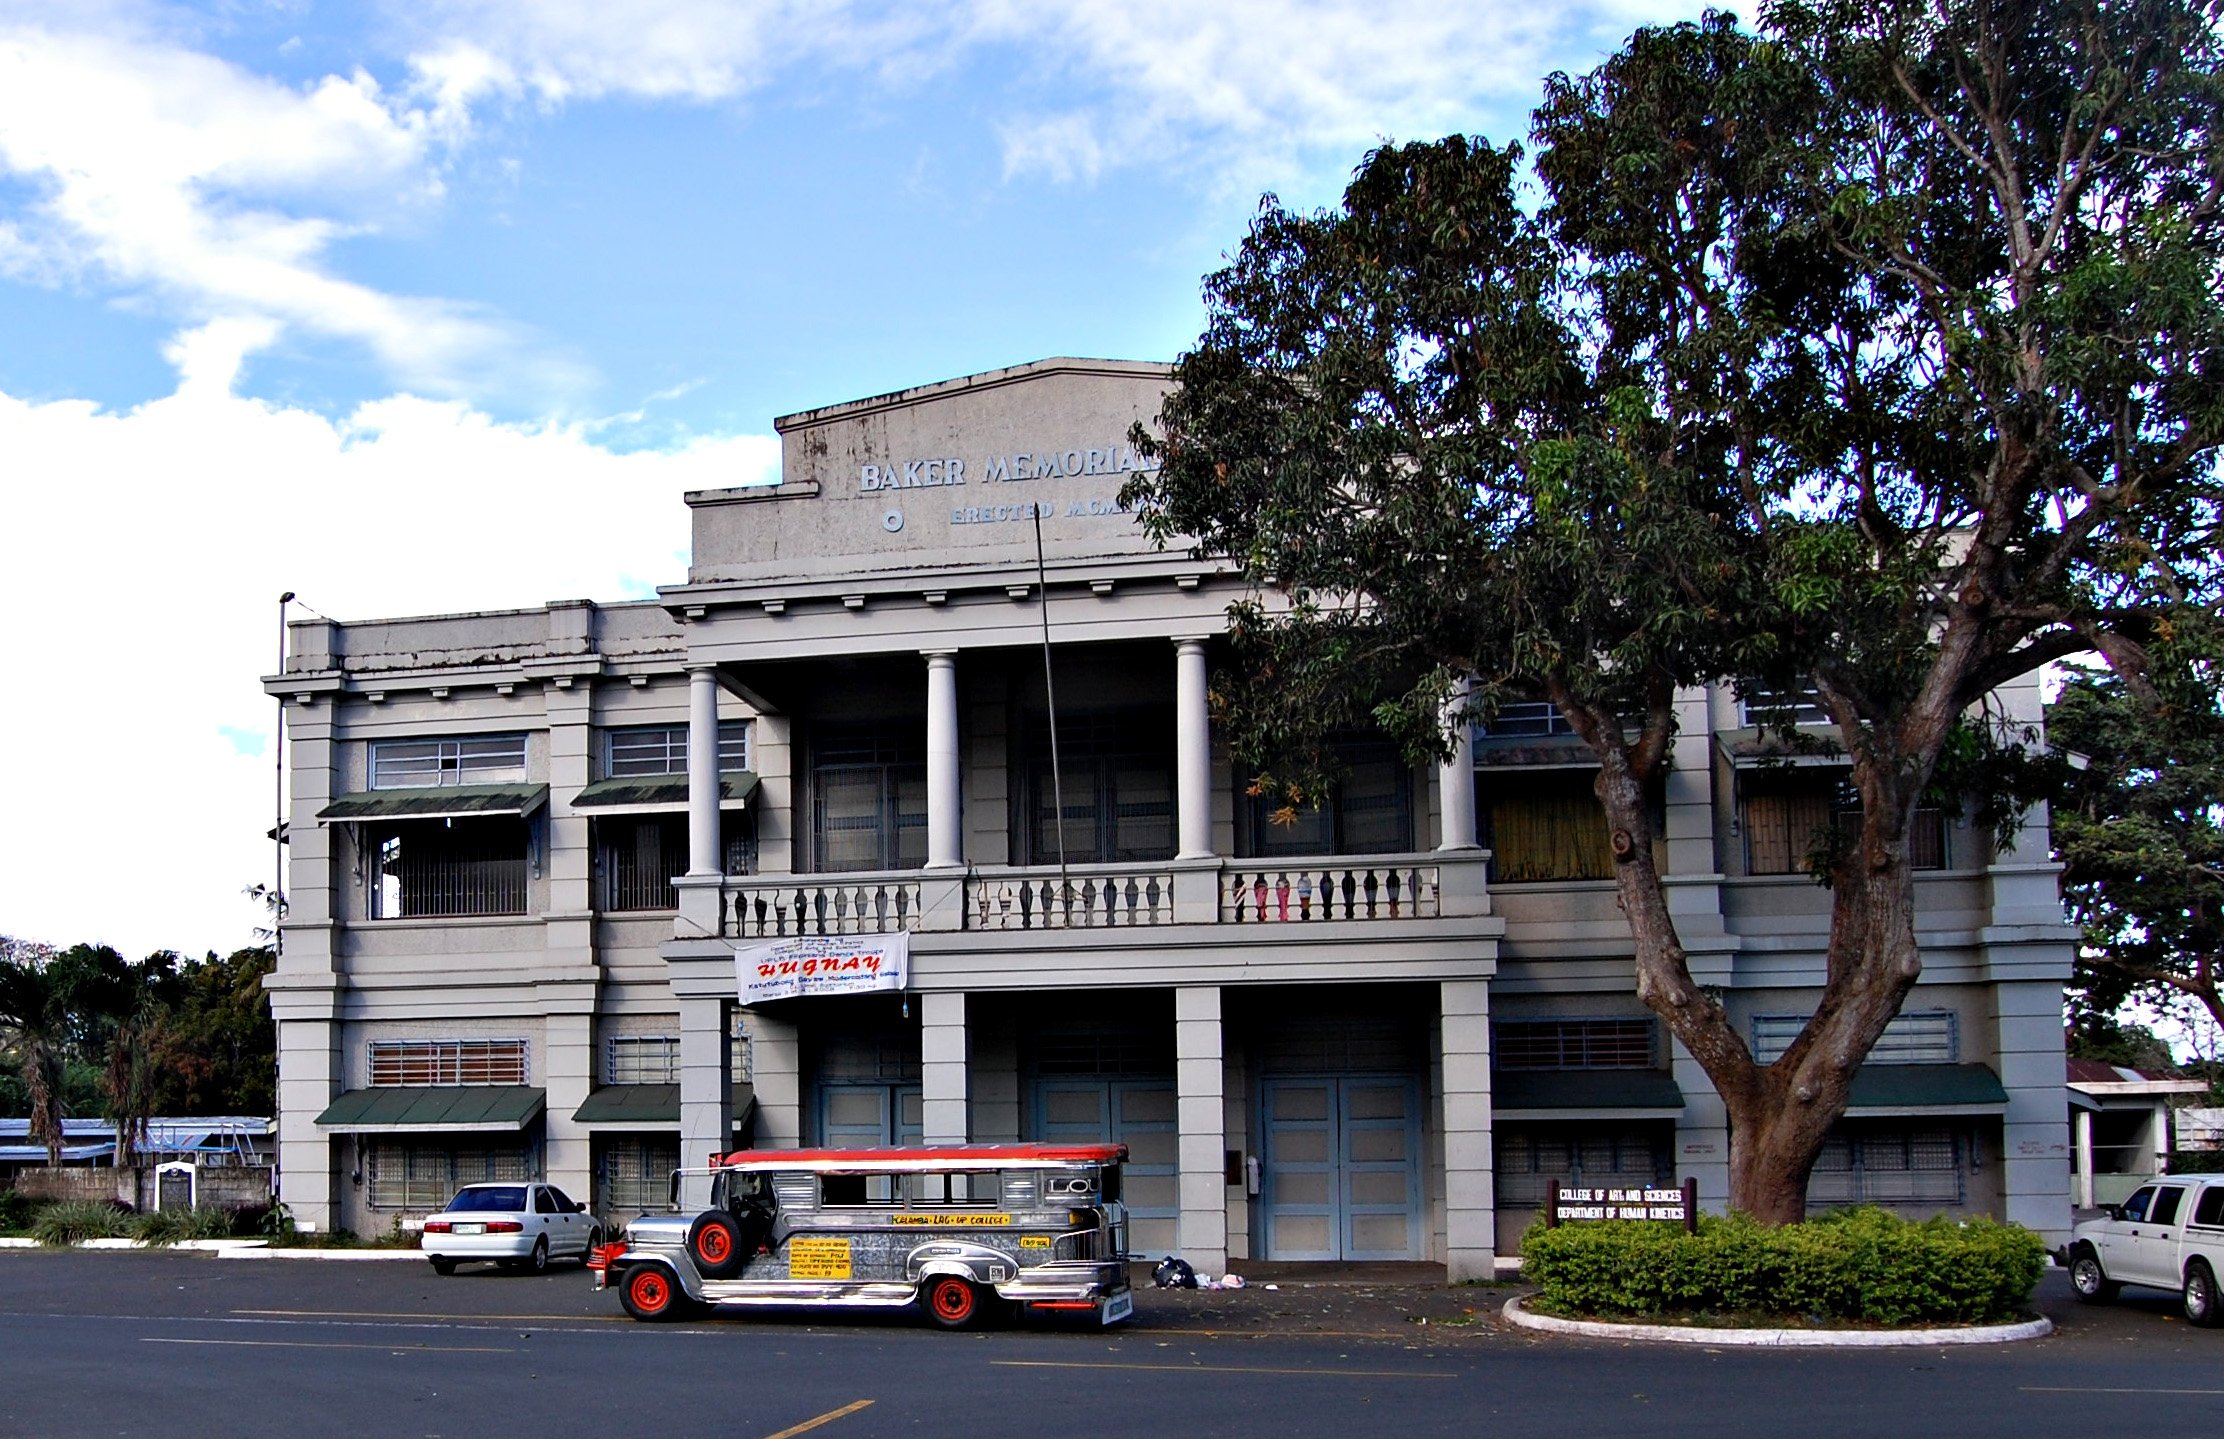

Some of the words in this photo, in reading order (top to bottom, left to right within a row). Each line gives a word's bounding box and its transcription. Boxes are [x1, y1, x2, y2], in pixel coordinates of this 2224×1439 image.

[860, 458, 966, 492] BAKER
[950, 501, 1054, 524] ERECTED
[1559, 1189, 1592, 1201] COLLEGE
[1594, 1189, 1605, 1201] OF
[1626, 1190, 1641, 1201] AND
[1644, 1190, 1682, 1202] SCIENCES
[1557, 1207, 1604, 1218] DEPARTMENT
[1606, 1207, 1616, 1218] OF
[1619, 1207, 1647, 1219] HUMAN
[1650, 1207, 1685, 1219] KINETICS
[970, 1216, 1004, 1224] COLLEGE
